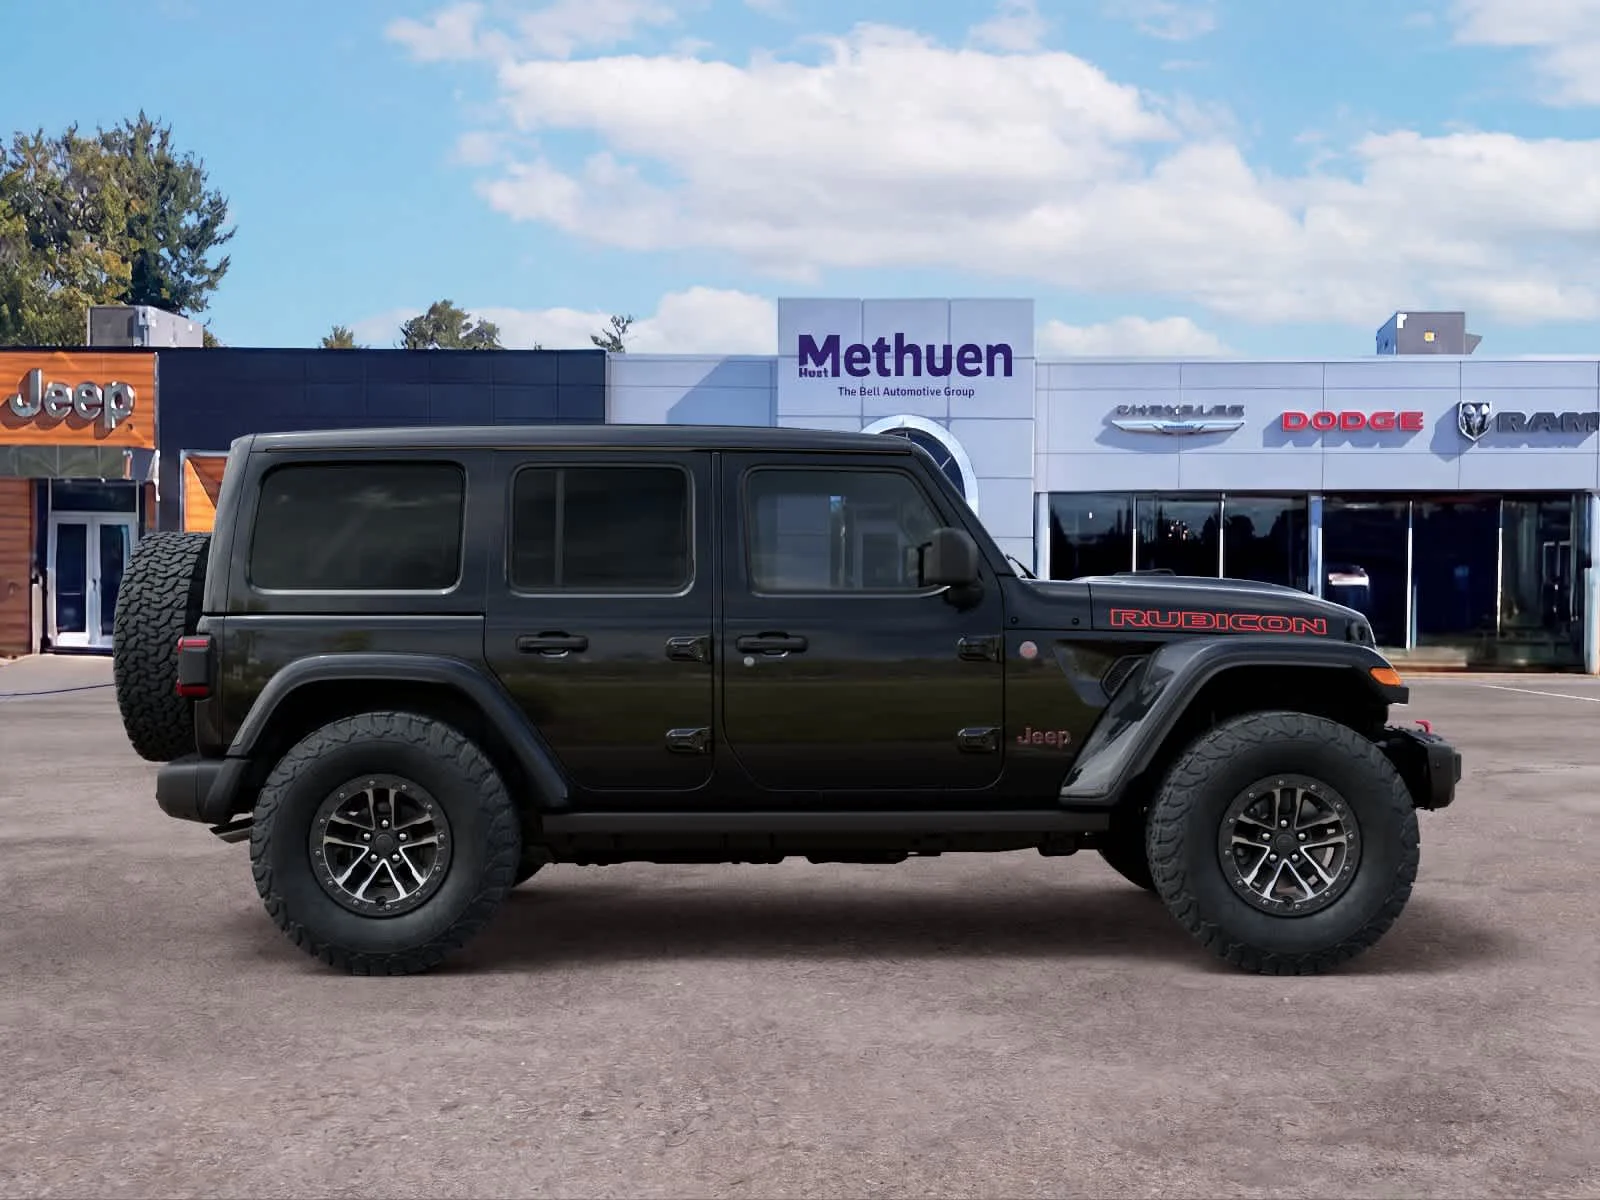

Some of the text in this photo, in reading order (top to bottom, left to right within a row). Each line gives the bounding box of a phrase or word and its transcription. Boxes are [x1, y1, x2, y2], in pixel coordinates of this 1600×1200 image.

[798, 332, 1013, 378] Methuen
[9, 368, 136, 429] Jeep
[838, 386, 975, 399] The Bell Automotive Group
[1282, 411, 1424, 432] DODGE
[1497, 411, 1600, 433] RAM
[1110, 608, 1328, 635] RUBICON
[1017, 727, 1071, 748] Jeep
